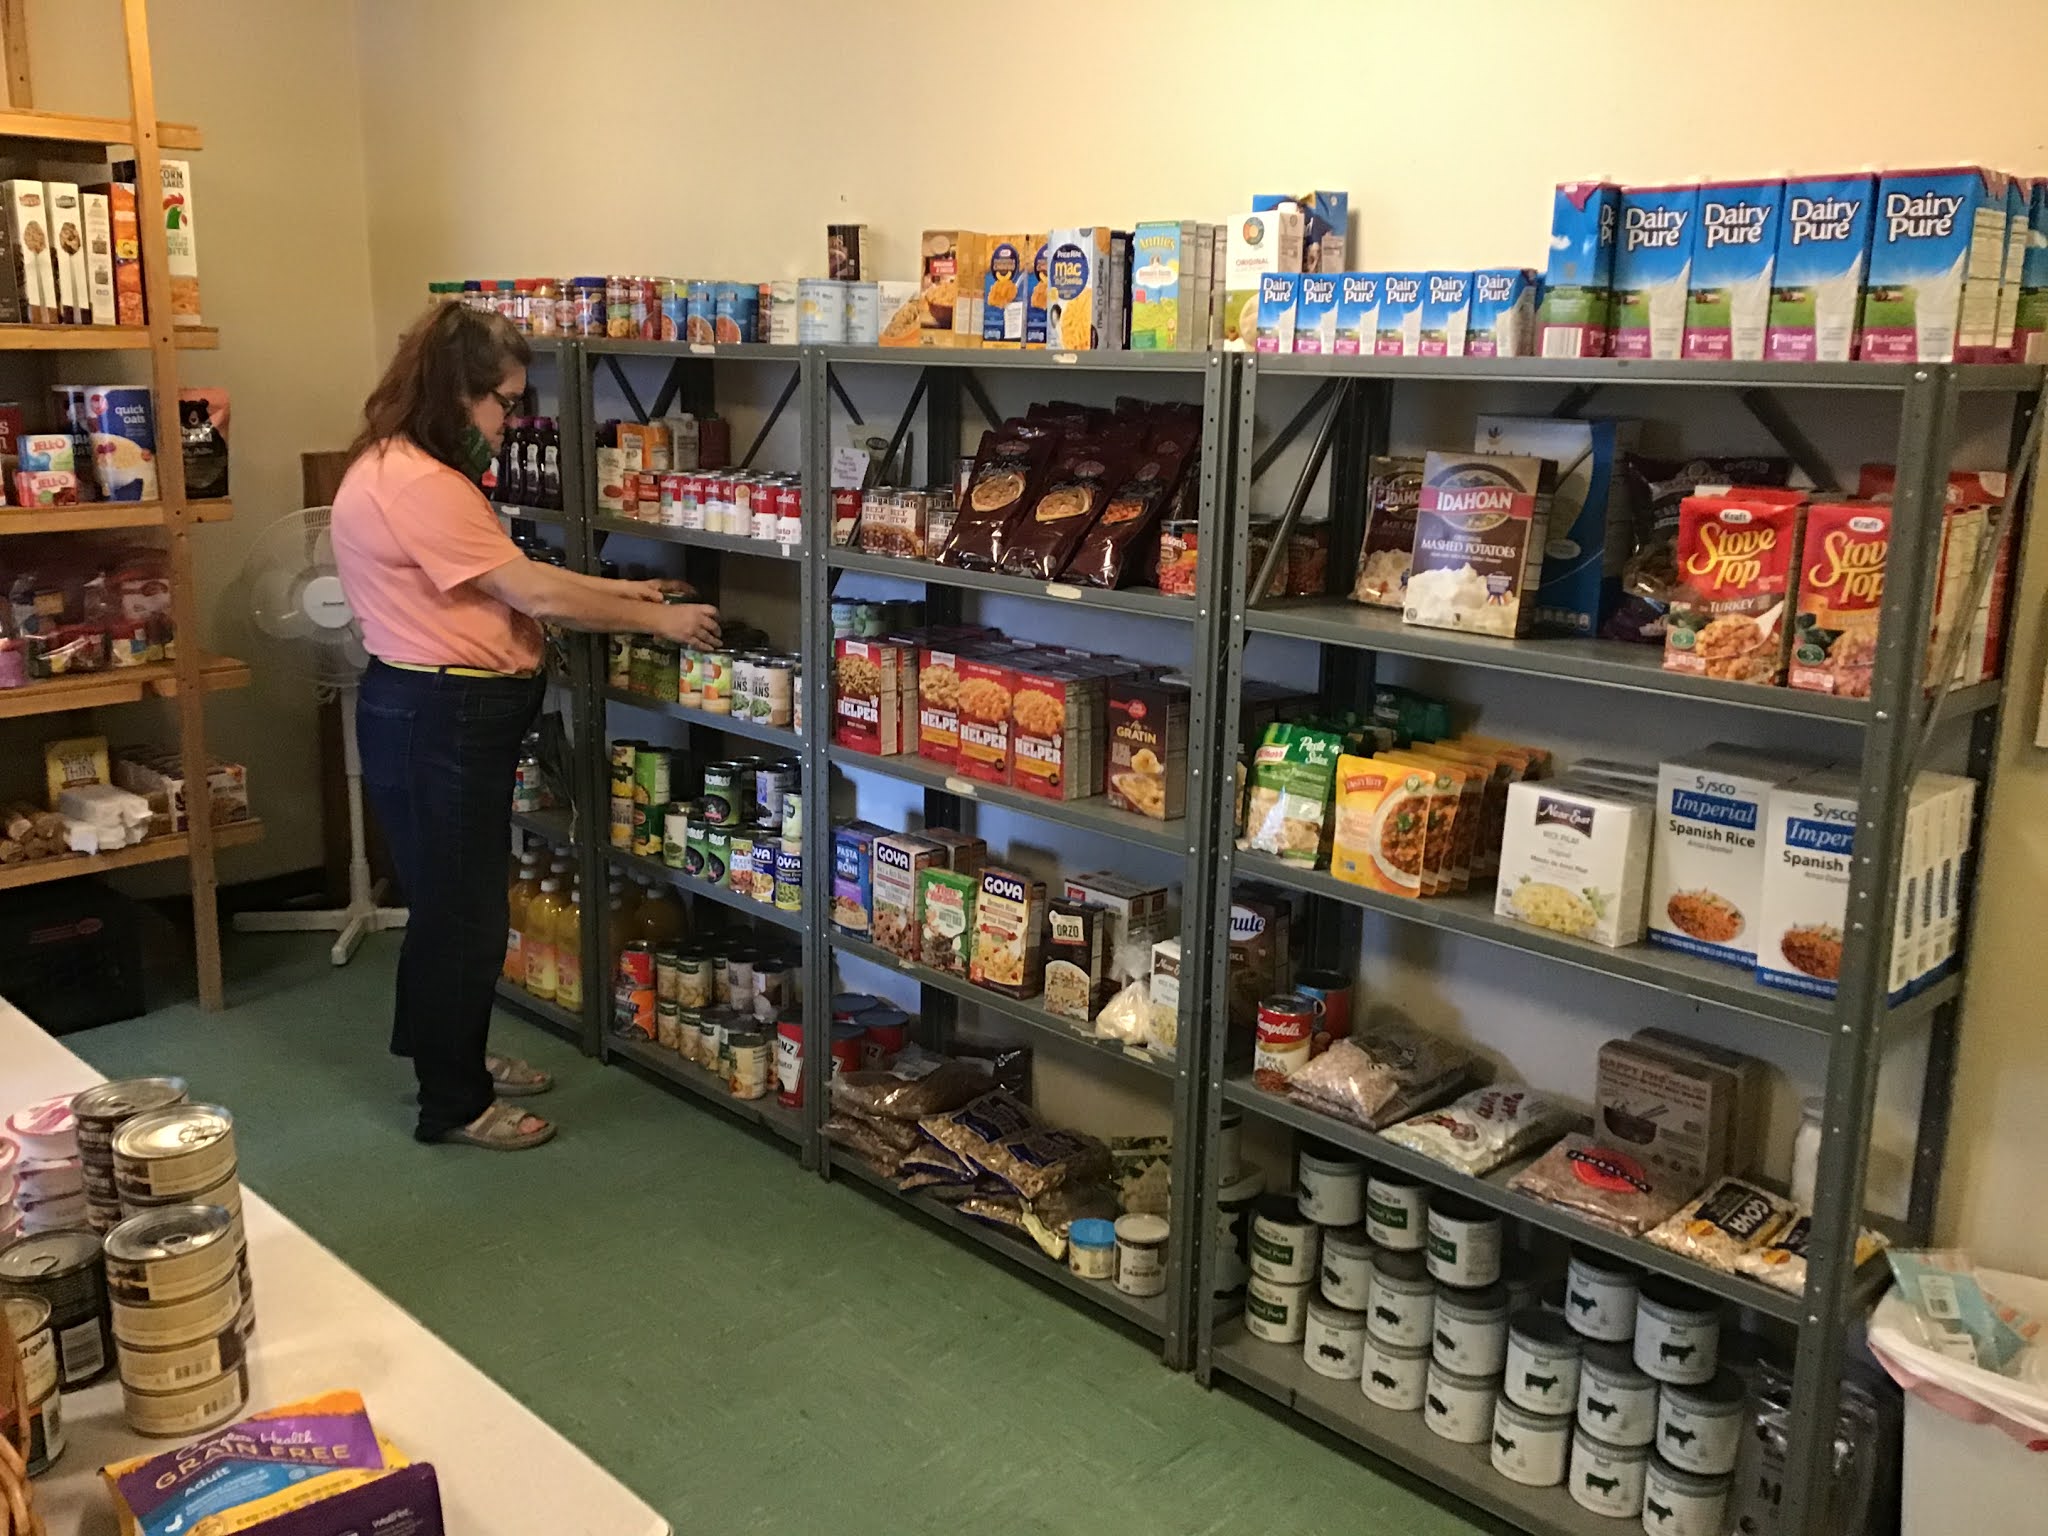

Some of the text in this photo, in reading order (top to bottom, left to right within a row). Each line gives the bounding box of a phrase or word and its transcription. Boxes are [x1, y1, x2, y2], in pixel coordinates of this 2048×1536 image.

[162, 180, 184, 189] LAKES
[1625, 206, 1688, 234] Dairy
[1704, 201, 1772, 233] Dairy
[1790, 197, 1861, 229] Dairy
[1886, 192, 1964, 228] Dairy
[1627, 228, 1680, 251] Pure
[1706, 223, 1763, 248] Pure
[1793, 219, 1851, 246] Pure
[1888, 217, 1952, 242] Pure
[1055, 262, 1082, 276] mac
[1263, 276, 1295, 294] Dairy
[1303, 278, 1336, 296] Dairy
[1343, 276, 1378, 296] Dairy
[1385, 276, 1421, 295] Dairy
[1429, 275, 1467, 294] Dairy
[1477, 274, 1515, 293] Dairy
[1264, 290, 1291, 304] Pure
[1305, 291, 1332, 304] Pure
[1344, 290, 1374, 304] Pure
[1386, 290, 1416, 304] Pure
[1430, 289, 1463, 304] Pure
[1478, 288, 1511, 302] Pure
[115, 405, 145, 417] quick
[124, 415, 146, 424] oats
[1385, 490, 1420, 504] IDAHO
[1436, 491, 1514, 511] IDAHOAN
[1724, 512, 1748, 521] Kraft
[1420, 538, 1463, 552] MASHED
[1465, 541, 1516, 559] POTATOES
[1687, 522, 1777, 575] Stove
[1808, 531, 1888, 588] Stov
[1712, 559, 1762, 590] Top
[1710, 599, 1754, 613] TURKEY
[837, 700, 879, 723] HELPER
[920, 711, 959, 732] HELPE
[960, 725, 1008, 749] HELPER
[1116, 726, 1157, 745] GRATIN
[1014, 737, 1062, 765] HELPER
[1539, 803, 1569, 820] Near
[1675, 791, 1755, 822] Imperial
[1669, 819, 1756, 849] Spanish Rice
[1789, 820, 1854, 848] Imper
[752, 845, 771, 860] OYA
[776, 853, 801, 869] OYA
[837, 846, 858, 861] PASTA
[878, 846, 909, 869] GOYA
[1782, 850, 1844, 872] Spanish
[984, 876, 1023, 901] GOYA
[1056, 923, 1079, 938] ORZO
[1230, 915, 1265, 933] nute
[1729, 1198, 1770, 1235] GOYA
[260, 1430, 317, 1445] Health
[155, 1442, 351, 1490] GRAIN FREE
[184, 1466, 232, 1498] Adult
